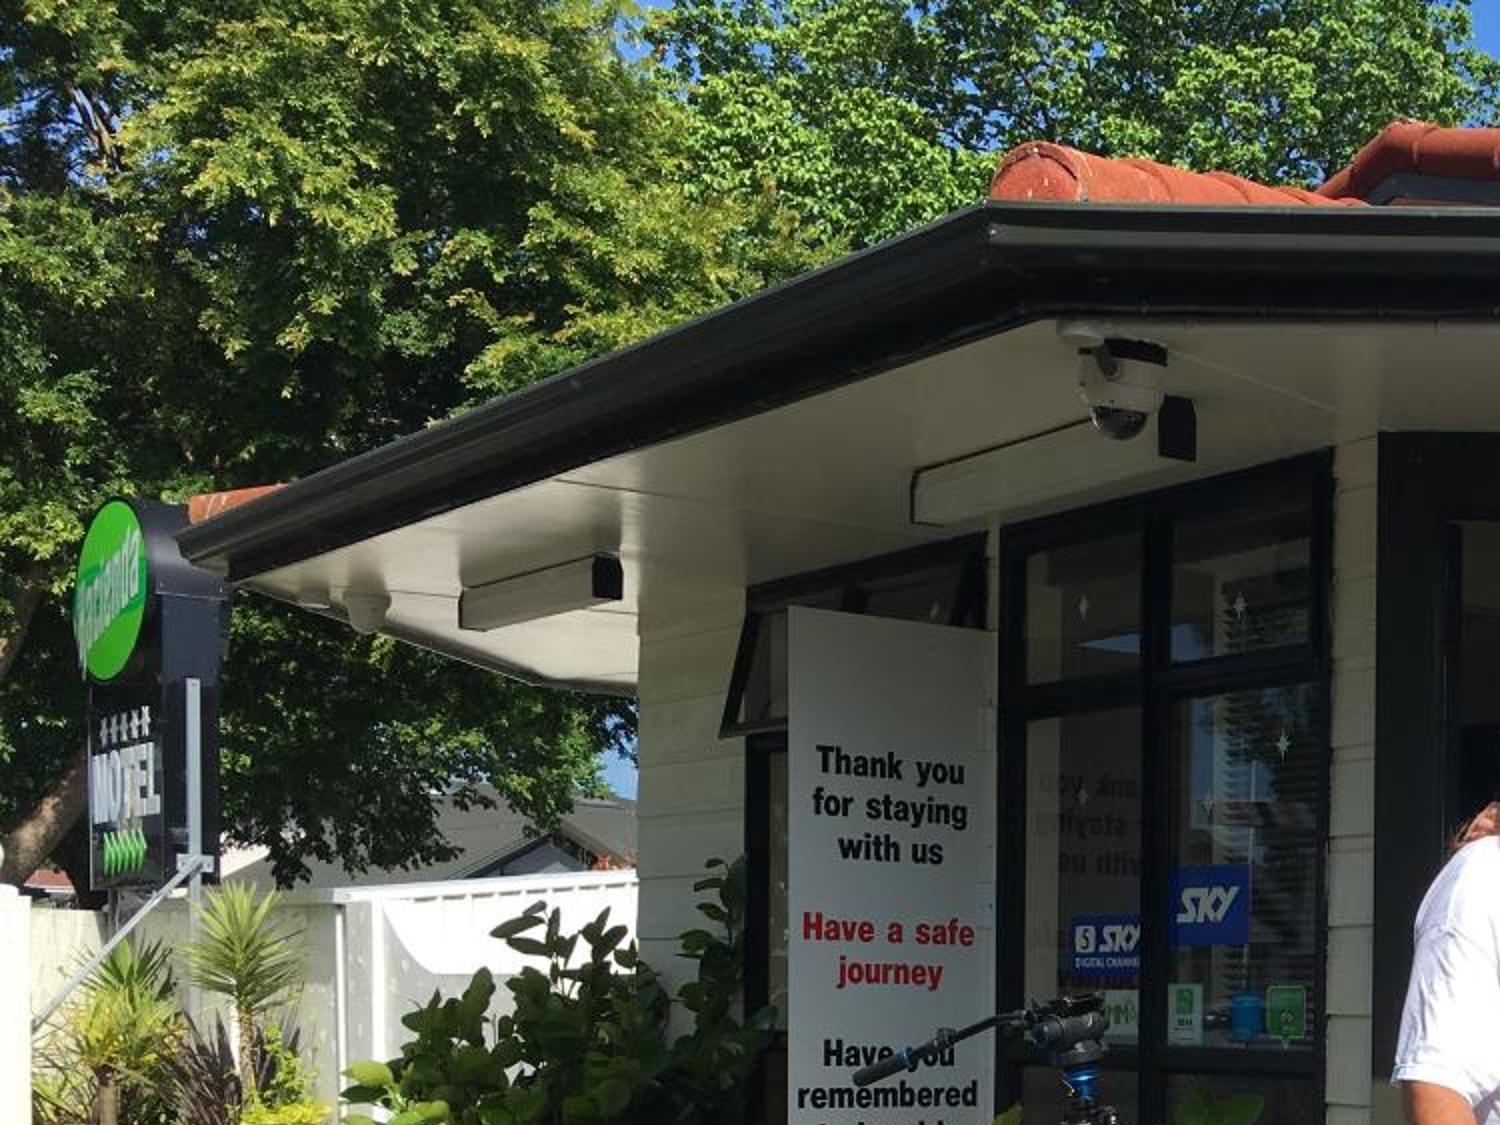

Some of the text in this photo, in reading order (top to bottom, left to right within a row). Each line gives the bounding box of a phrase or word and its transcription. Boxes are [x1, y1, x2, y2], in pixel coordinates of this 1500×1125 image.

[92, 742, 160, 823] MOTEL
[816, 745, 965, 787] Thank you
[813, 786, 967, 830] for staying
[838, 833, 944, 864] with us
[1177, 886, 1240, 923] SKY
[803, 912, 974, 947] Have a safe
[1098, 925, 1140, 952] SKY
[837, 955, 944, 991] journey
[823, 1039, 893, 1067] Have
[798, 1080, 977, 1108] remembered
